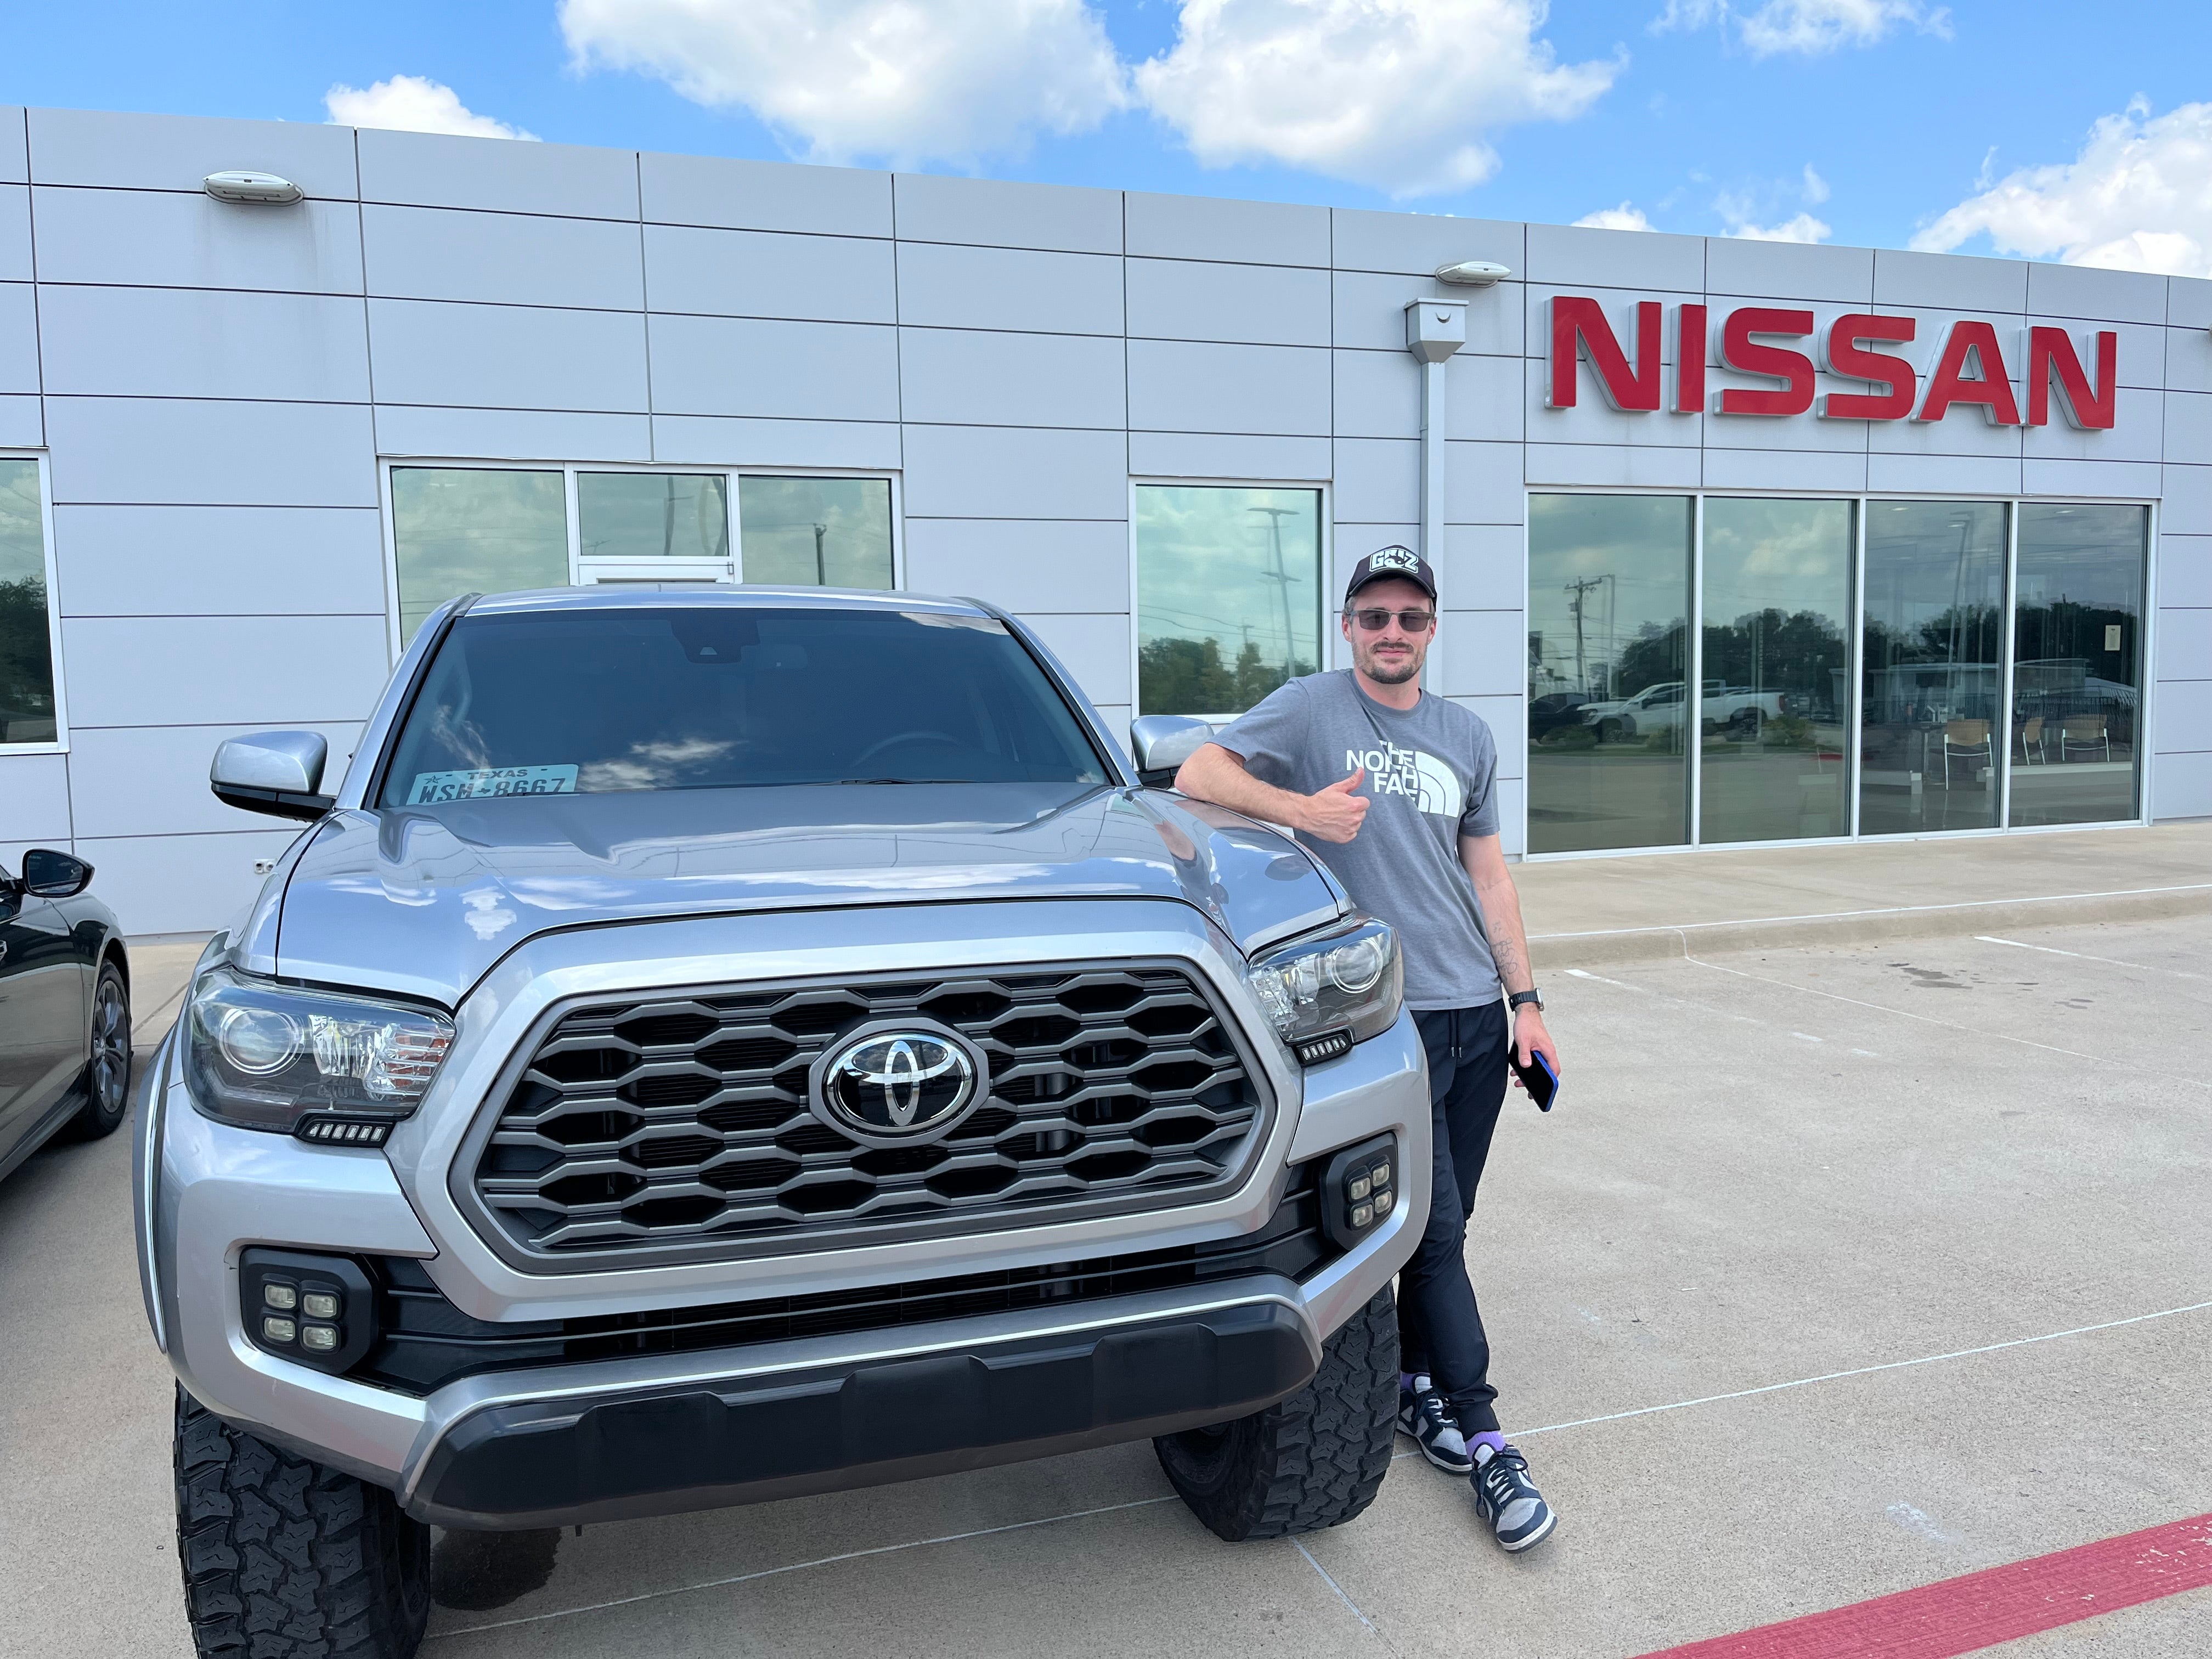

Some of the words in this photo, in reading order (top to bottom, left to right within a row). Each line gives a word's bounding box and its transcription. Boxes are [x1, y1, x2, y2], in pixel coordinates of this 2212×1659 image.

[1547, 296, 2117, 430] NISSAN
[1370, 548, 1419, 573] GRIZ
[467, 769, 528, 780] TEXAS
[1346, 749, 1419, 789] NOH
[418, 783, 475, 804] WSM
[493, 777, 566, 797] 8667
